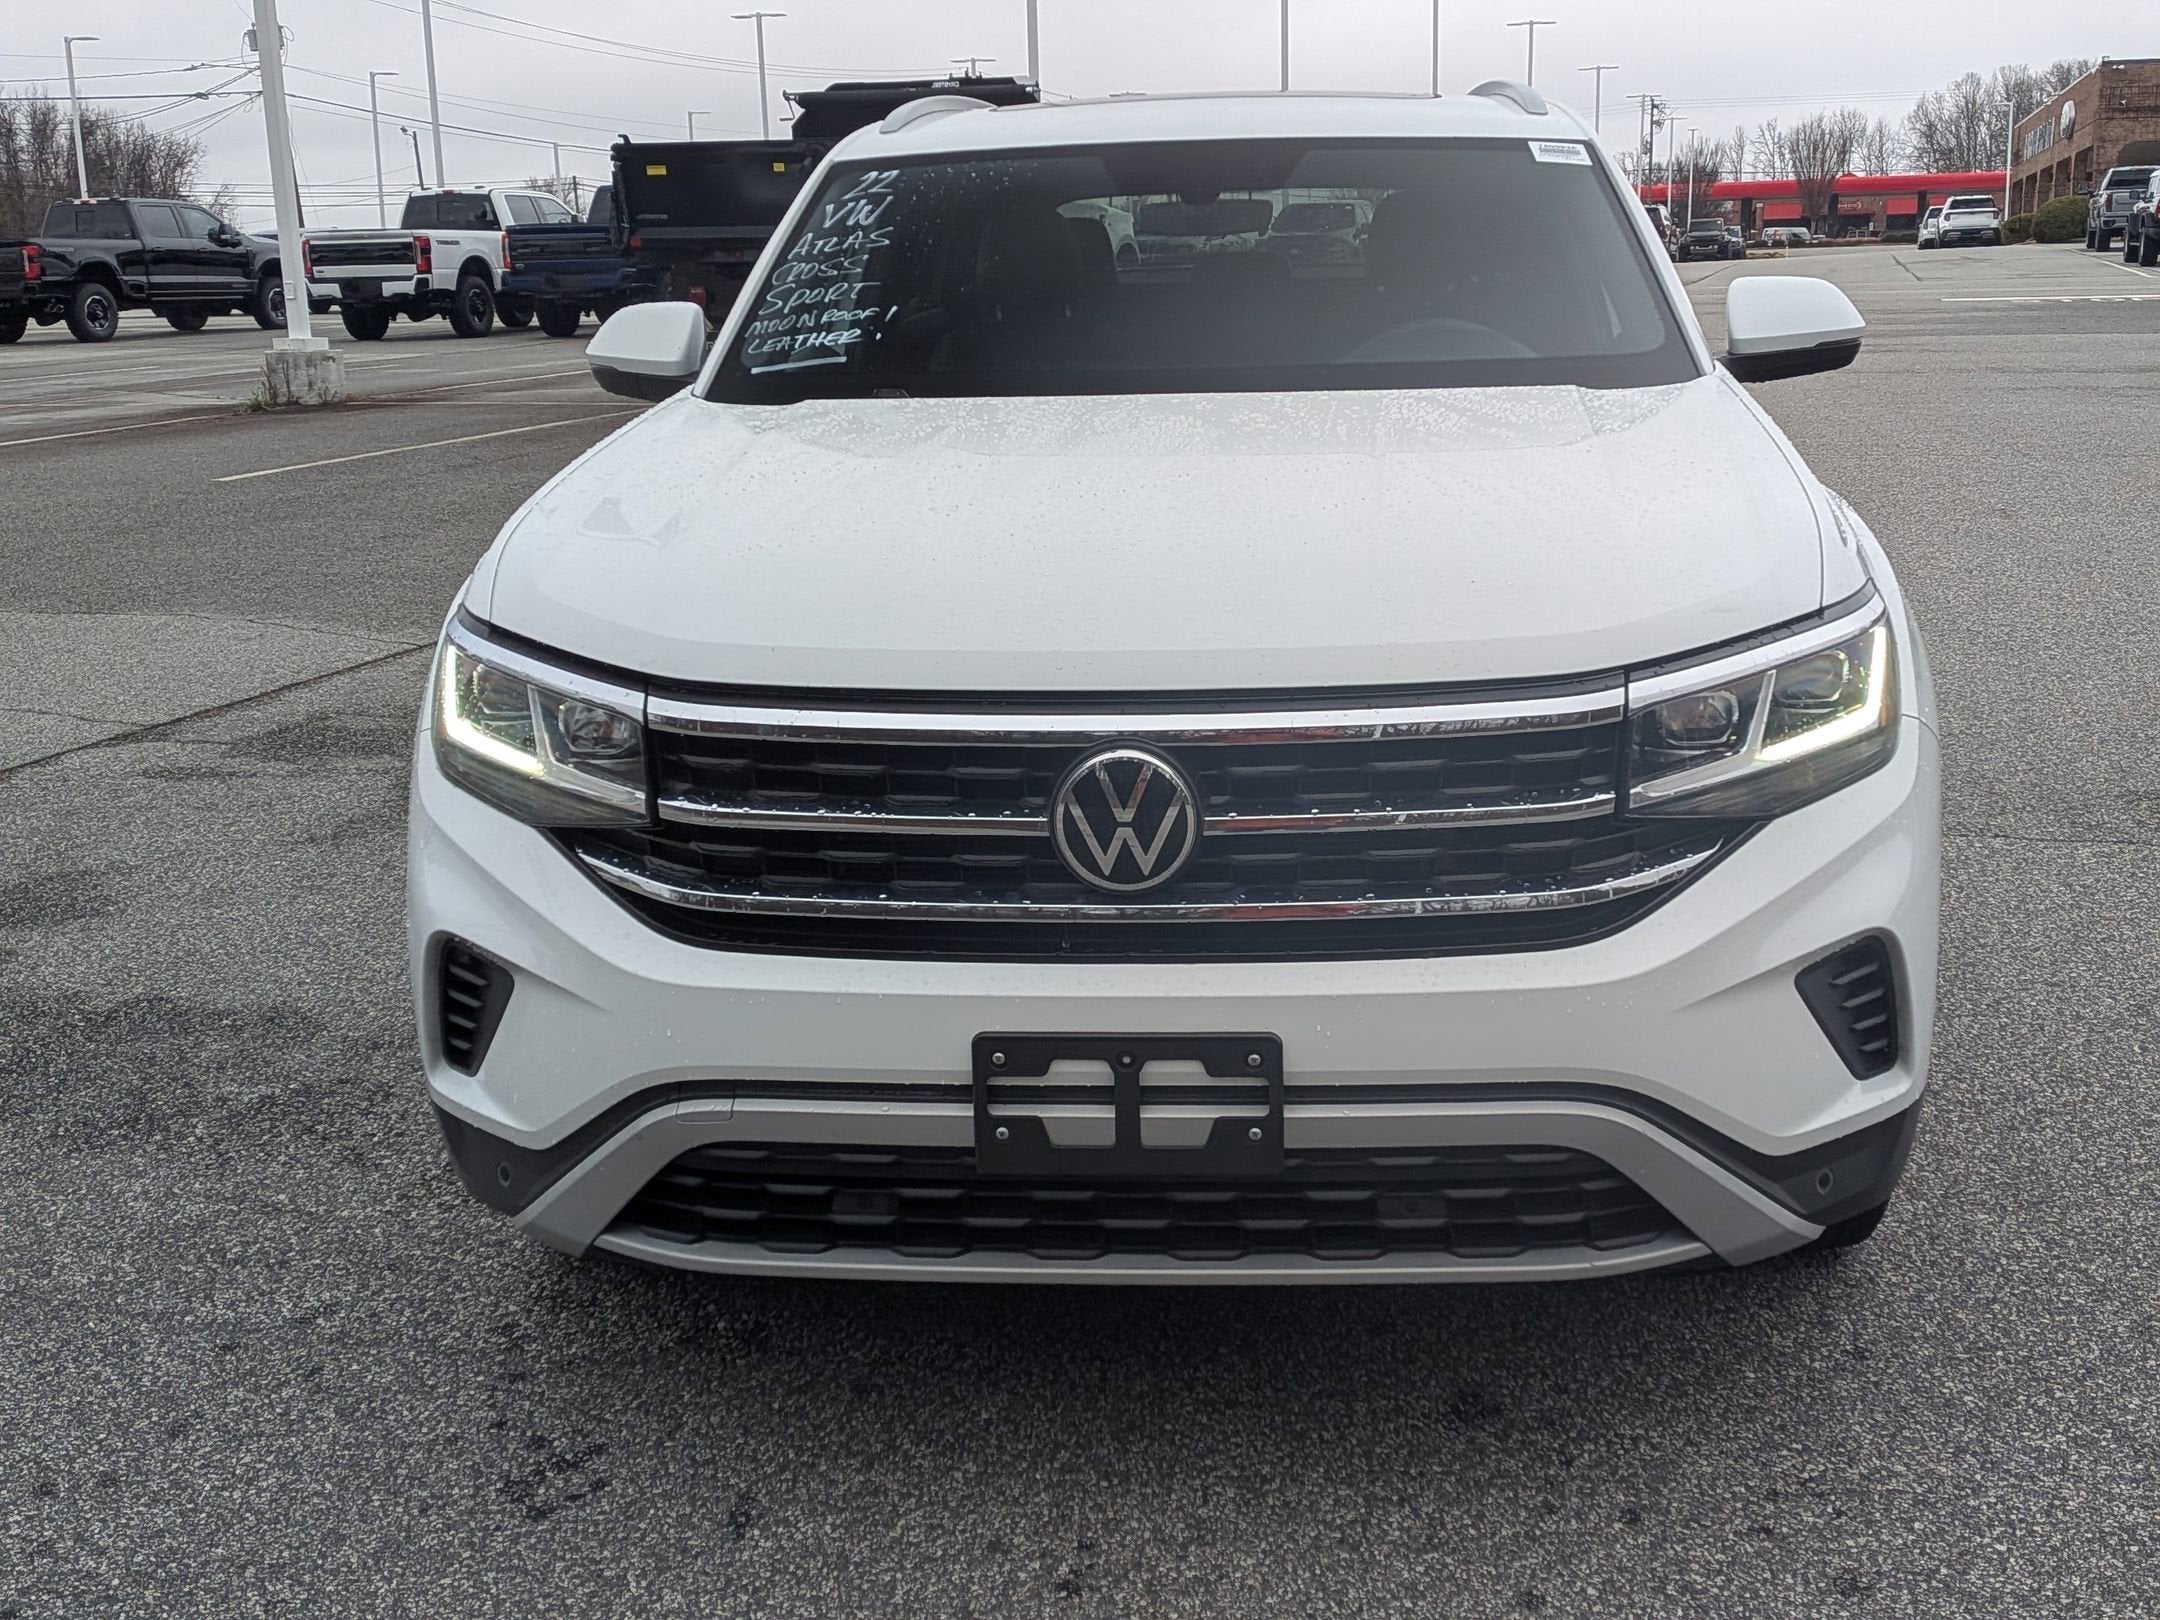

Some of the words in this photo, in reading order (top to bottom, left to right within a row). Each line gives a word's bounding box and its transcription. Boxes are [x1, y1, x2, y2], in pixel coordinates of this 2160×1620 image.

[840, 169, 900, 200] 22
[823, 195, 894, 228] VW
[787, 226, 894, 260] ATLAS
[772, 254, 869, 286] CROSS
[758, 281, 882, 315] SPORT
[1062, 758, 1188, 878] VW
